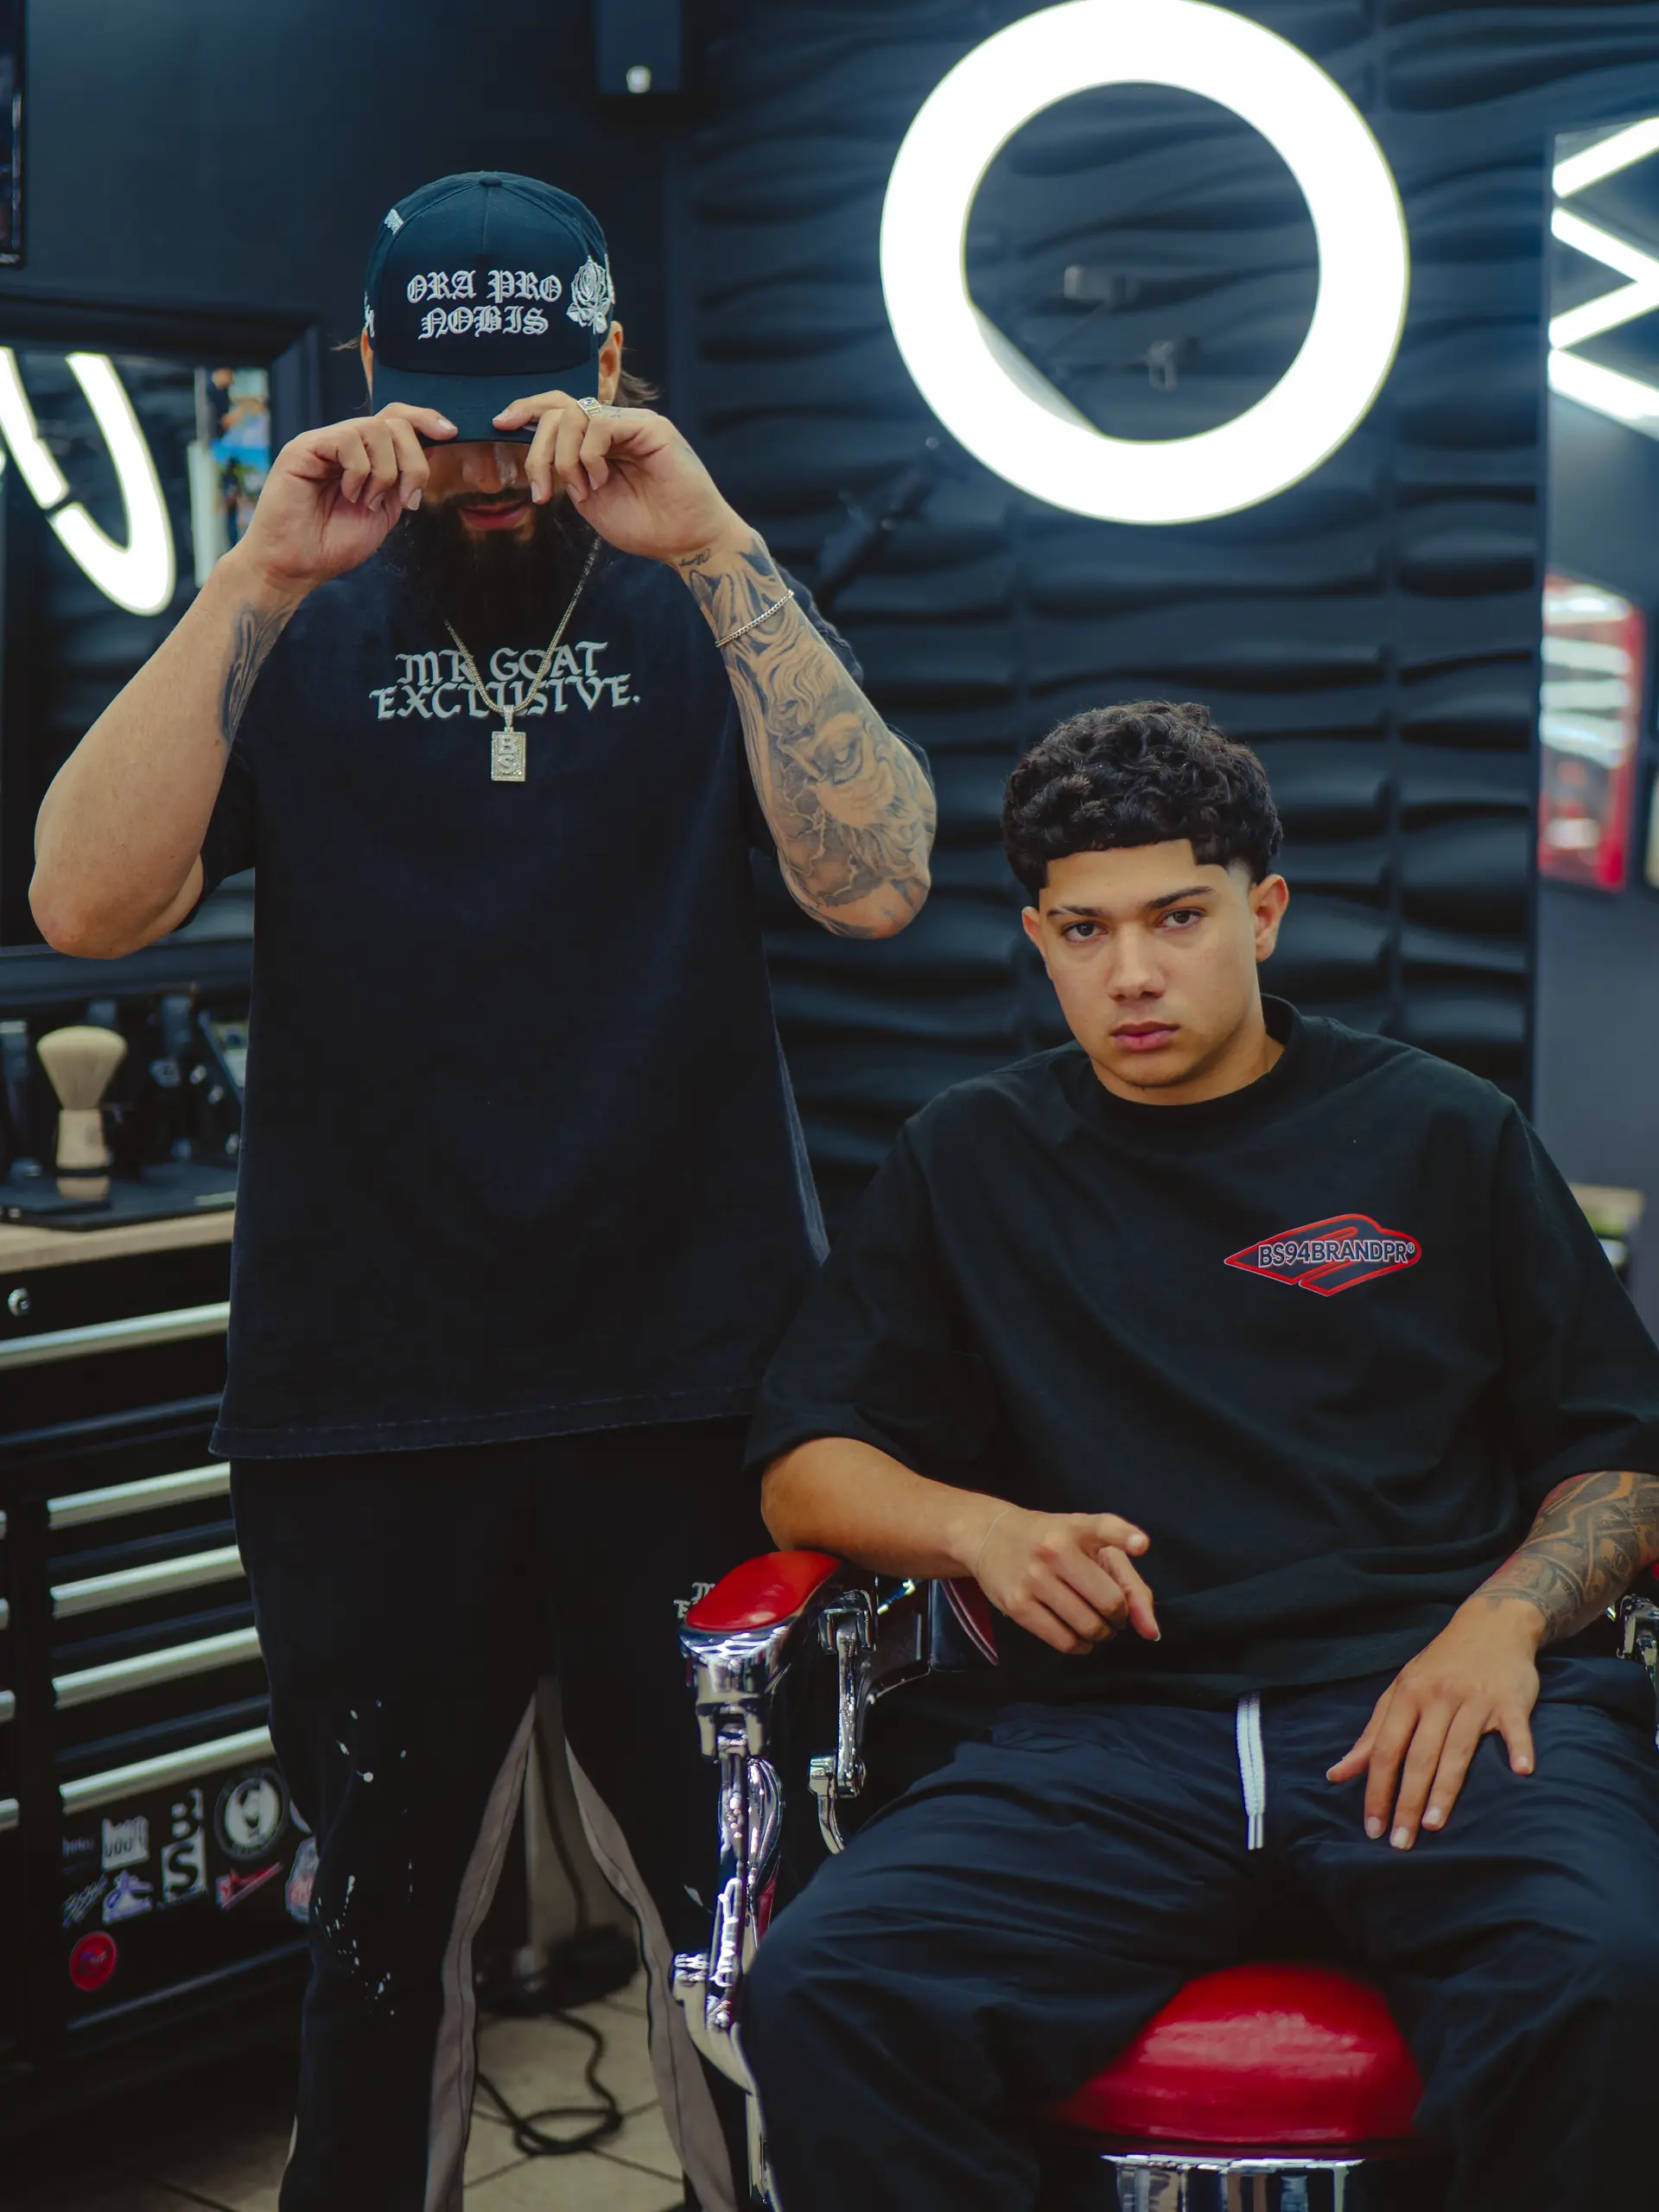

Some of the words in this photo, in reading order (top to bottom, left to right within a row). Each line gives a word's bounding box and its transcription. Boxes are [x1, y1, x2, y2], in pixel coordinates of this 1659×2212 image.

[406, 270, 477, 303] ORA
[486, 270, 562, 303] PRO
[417, 305, 549, 340] NOBIS
[489, 640, 608, 682] GOAT
